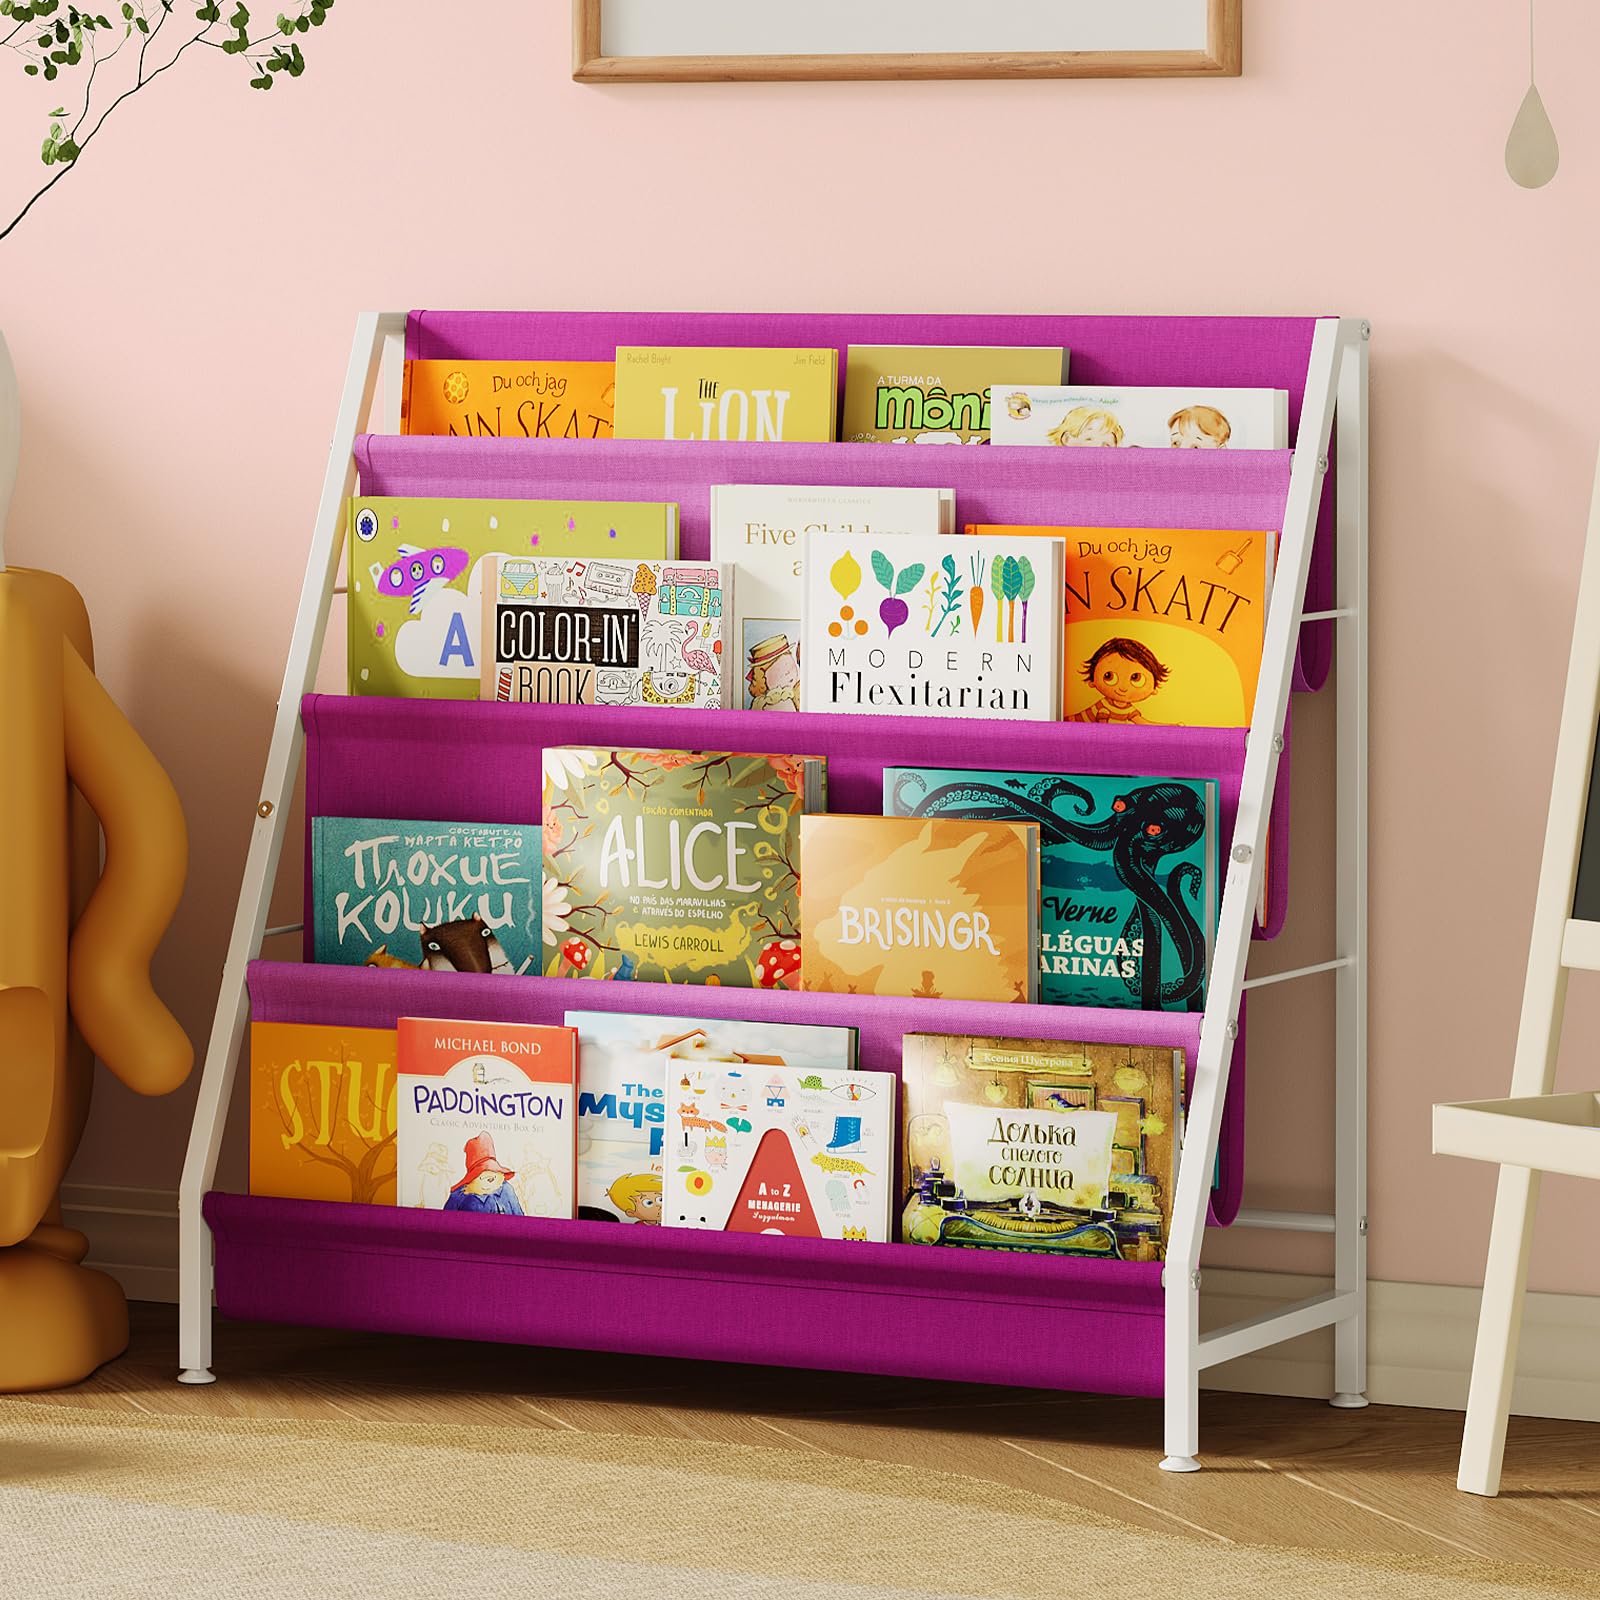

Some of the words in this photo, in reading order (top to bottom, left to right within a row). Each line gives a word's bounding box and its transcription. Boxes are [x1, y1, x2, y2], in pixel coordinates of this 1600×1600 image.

[492, 375, 512, 393] Du
[515, 371, 541, 388] och
[536, 373, 568, 398] jag
[699, 378, 719, 400] THE
[877, 376, 885, 385] A
[887, 375, 924, 386] TURMA
[926, 376, 942, 386] DA
[661, 386, 791, 442] LION
[745, 522, 796, 546] Five
[1078, 541, 1102, 559] Du
[1107, 538, 1139, 554] och
[1133, 540, 1173, 564] jag
[1106, 565, 1252, 635] SKATT
[828, 647, 1033, 674] MODERN
[518, 666, 592, 705] BOOK
[827, 671, 1031, 711] Flexitarian
[669, 807, 714, 818] COMENTADA
[404, 835, 458, 848] МАРТА
[463, 835, 523, 849] КЕТРО
[599, 814, 763, 894] ALICE
[641, 905, 673, 917] ATRAVÉS
[674, 908, 685, 918] DO
[687, 909, 724, 920] ESPELHO
[659, 896, 675, 907] DAS
[676, 897, 727, 908] MARAVILHAS
[1042, 896, 1119, 924] Verne
[634, 933, 670, 950] LEWIS
[672, 935, 724, 953] CARROLL
[837, 905, 1001, 957] BRISINGR
[1040, 929, 1144, 957] LÉGUAS
[434, 1036, 497, 1054] MICHAEL
[500, 1040, 542, 1056] BOND
[984, 1053, 1019, 1064] Ксения
[1020, 1055, 1074, 1068] Шустрова
[413, 1084, 563, 1120] PADDINGTON
[621, 1083, 664, 1099] The
[280, 1059, 397, 1150] STU
[758, 1181, 768, 1196] A
[770, 1187, 780, 1196] to
[782, 1183, 792, 1198] Z
[747, 1199, 801, 1213] MENAGERIE
